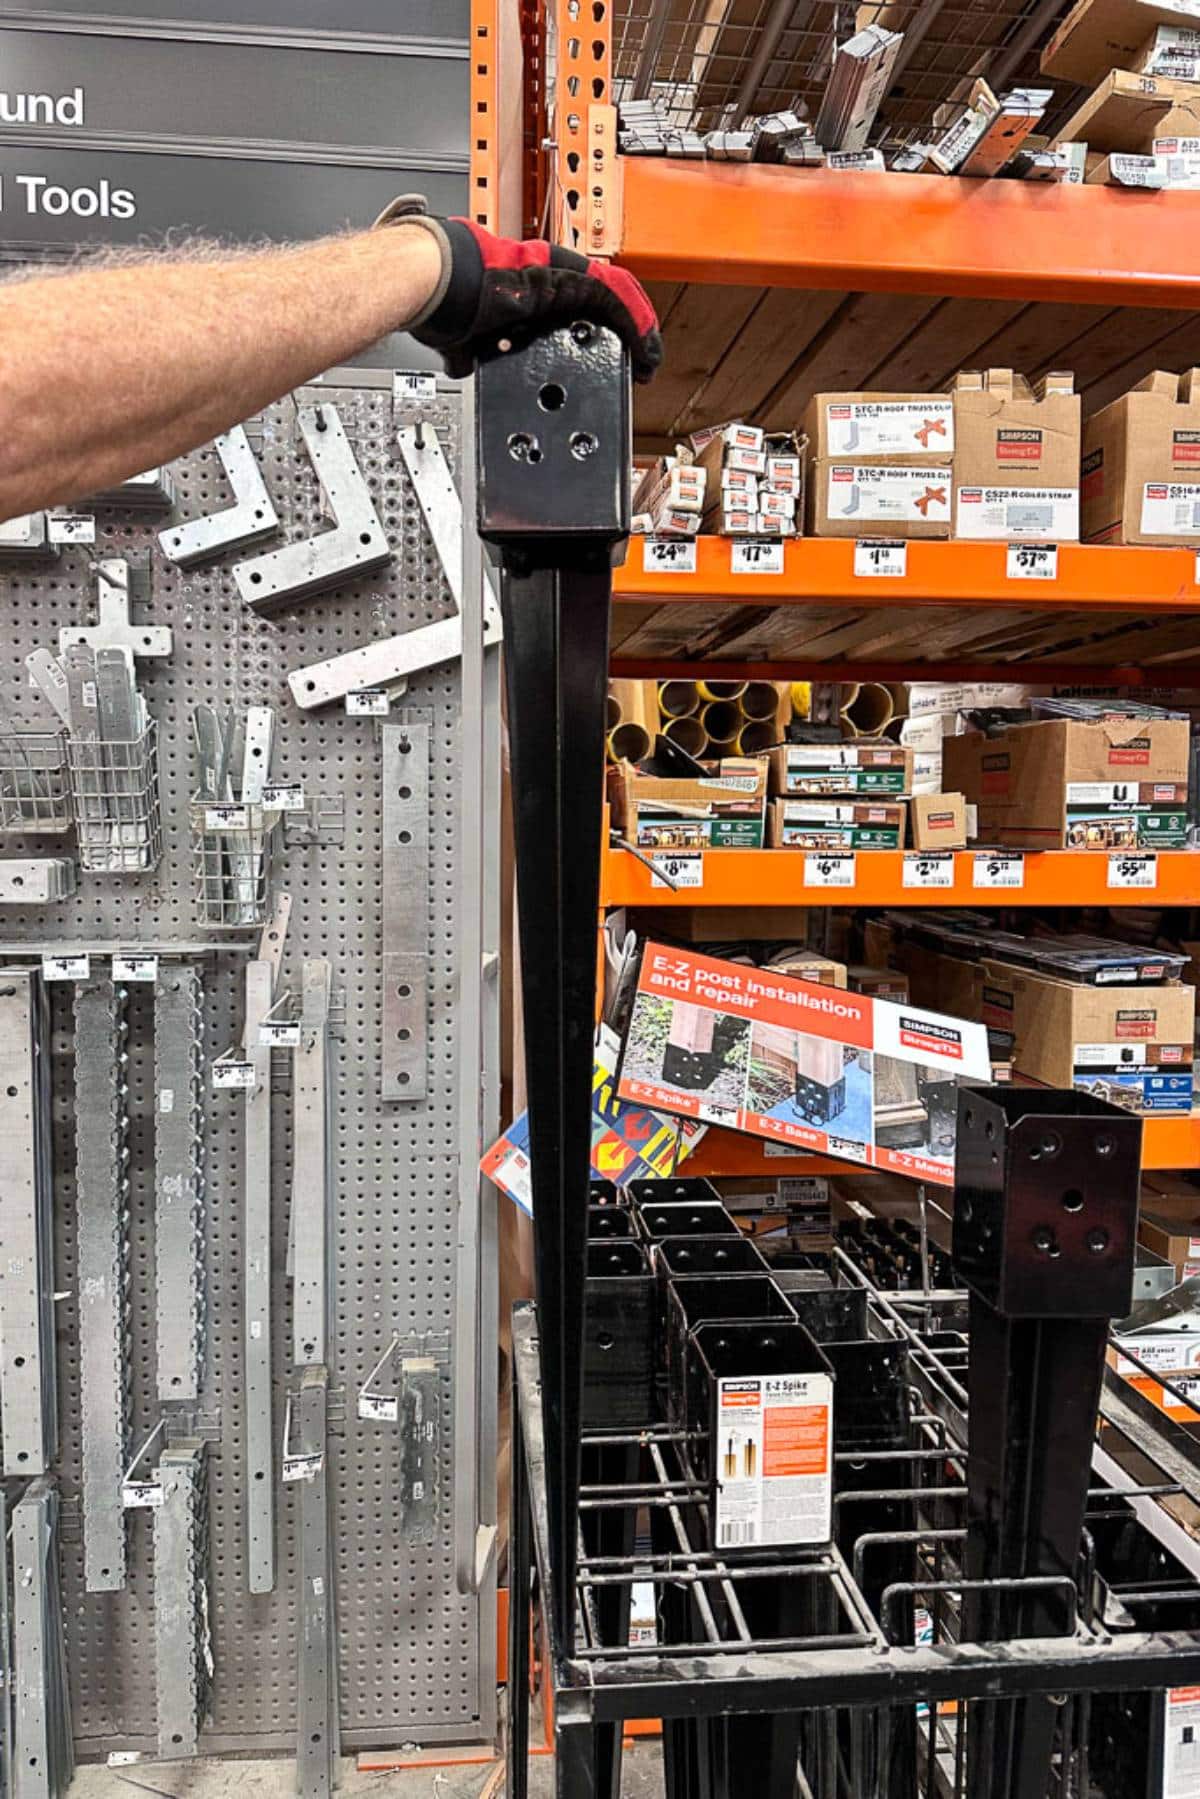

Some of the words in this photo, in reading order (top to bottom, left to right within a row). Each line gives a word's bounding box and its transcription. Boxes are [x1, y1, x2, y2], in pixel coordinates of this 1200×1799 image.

[0, 87, 84, 125] und
[16, 175, 136, 219] Tools
[1000, 431, 1039, 441] SIMPSON
[650, 972, 691, 992] and
[696, 984, 760, 1009] repair
[653, 956, 690, 976] E-Z
[694, 969, 742, 991] post
[747, 979, 862, 1021] installation
[902, 1020, 960, 1042] SIMPSON
[630, 1083, 653, 1097] E-Z
[759, 1118, 782, 1134] E-Z
[888, 1151, 913, 1169] E-Z
[783, 1379, 808, 1392] Spike
